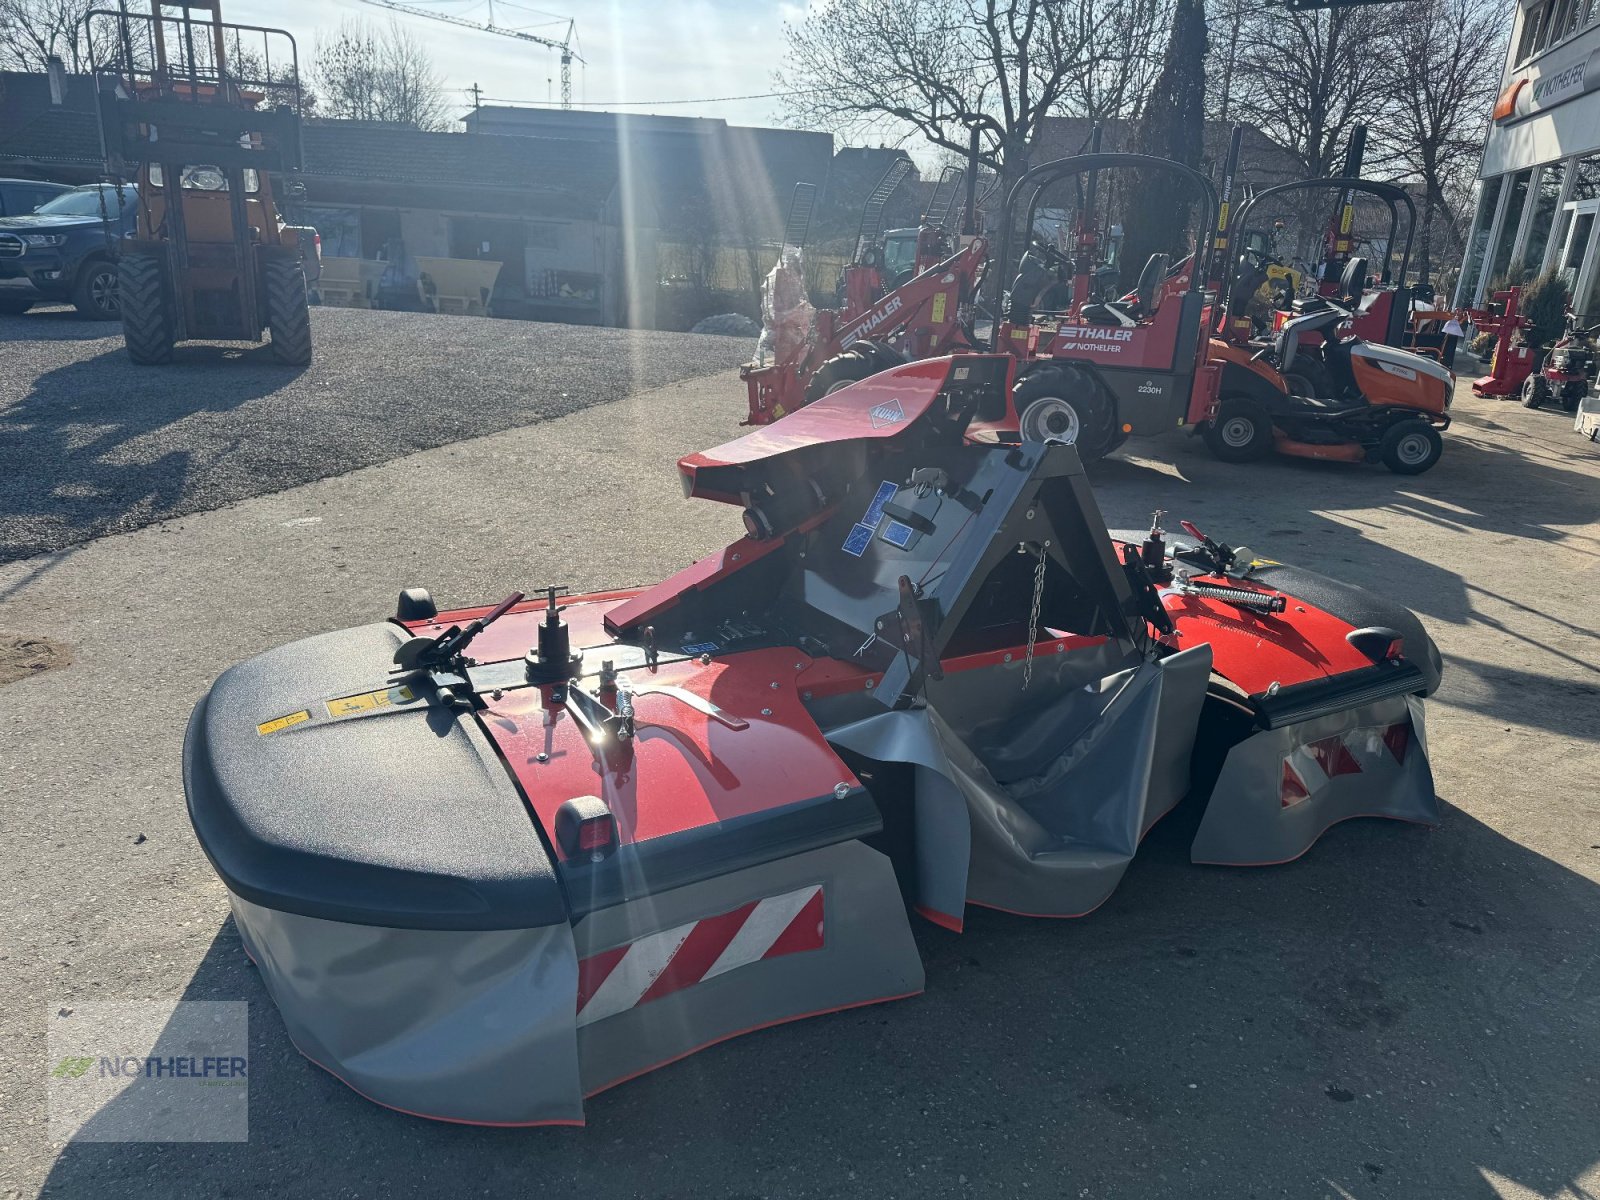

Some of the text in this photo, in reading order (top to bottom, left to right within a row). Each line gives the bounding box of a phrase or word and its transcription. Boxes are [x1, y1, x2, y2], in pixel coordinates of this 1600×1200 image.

[855, 296, 903, 338] THALER
[1079, 327, 1133, 342] THALER
[1076, 343, 1122, 353] NOTHELFER
[1137, 385, 1162, 395] 2230H
[872, 406, 902, 422] KUHN
